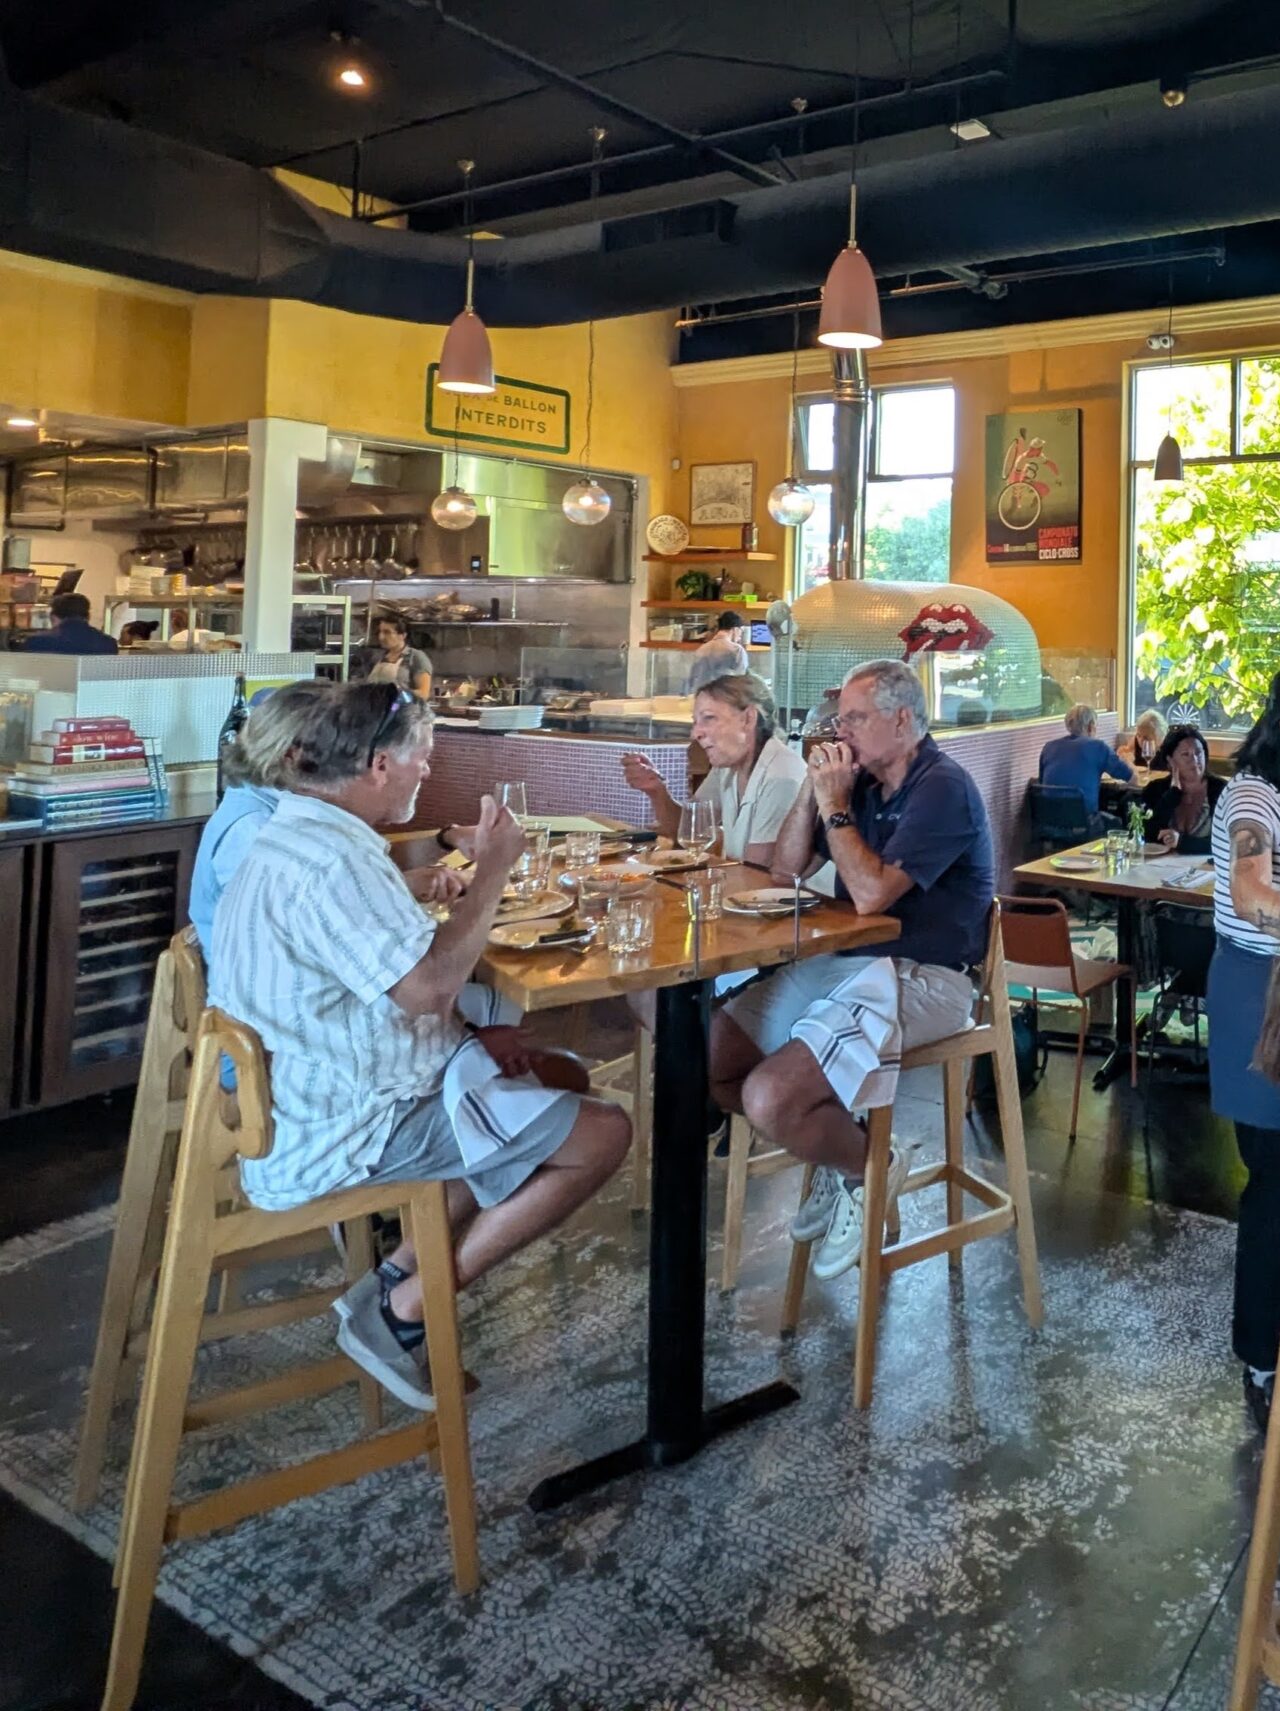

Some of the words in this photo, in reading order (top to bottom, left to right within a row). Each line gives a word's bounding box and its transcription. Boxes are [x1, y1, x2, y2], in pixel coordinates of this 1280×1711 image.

[503, 394, 557, 414] BALLON
[455, 405, 547, 434] INTERDITS
[1038, 547, 1080, 560] CICLO-CROSS
